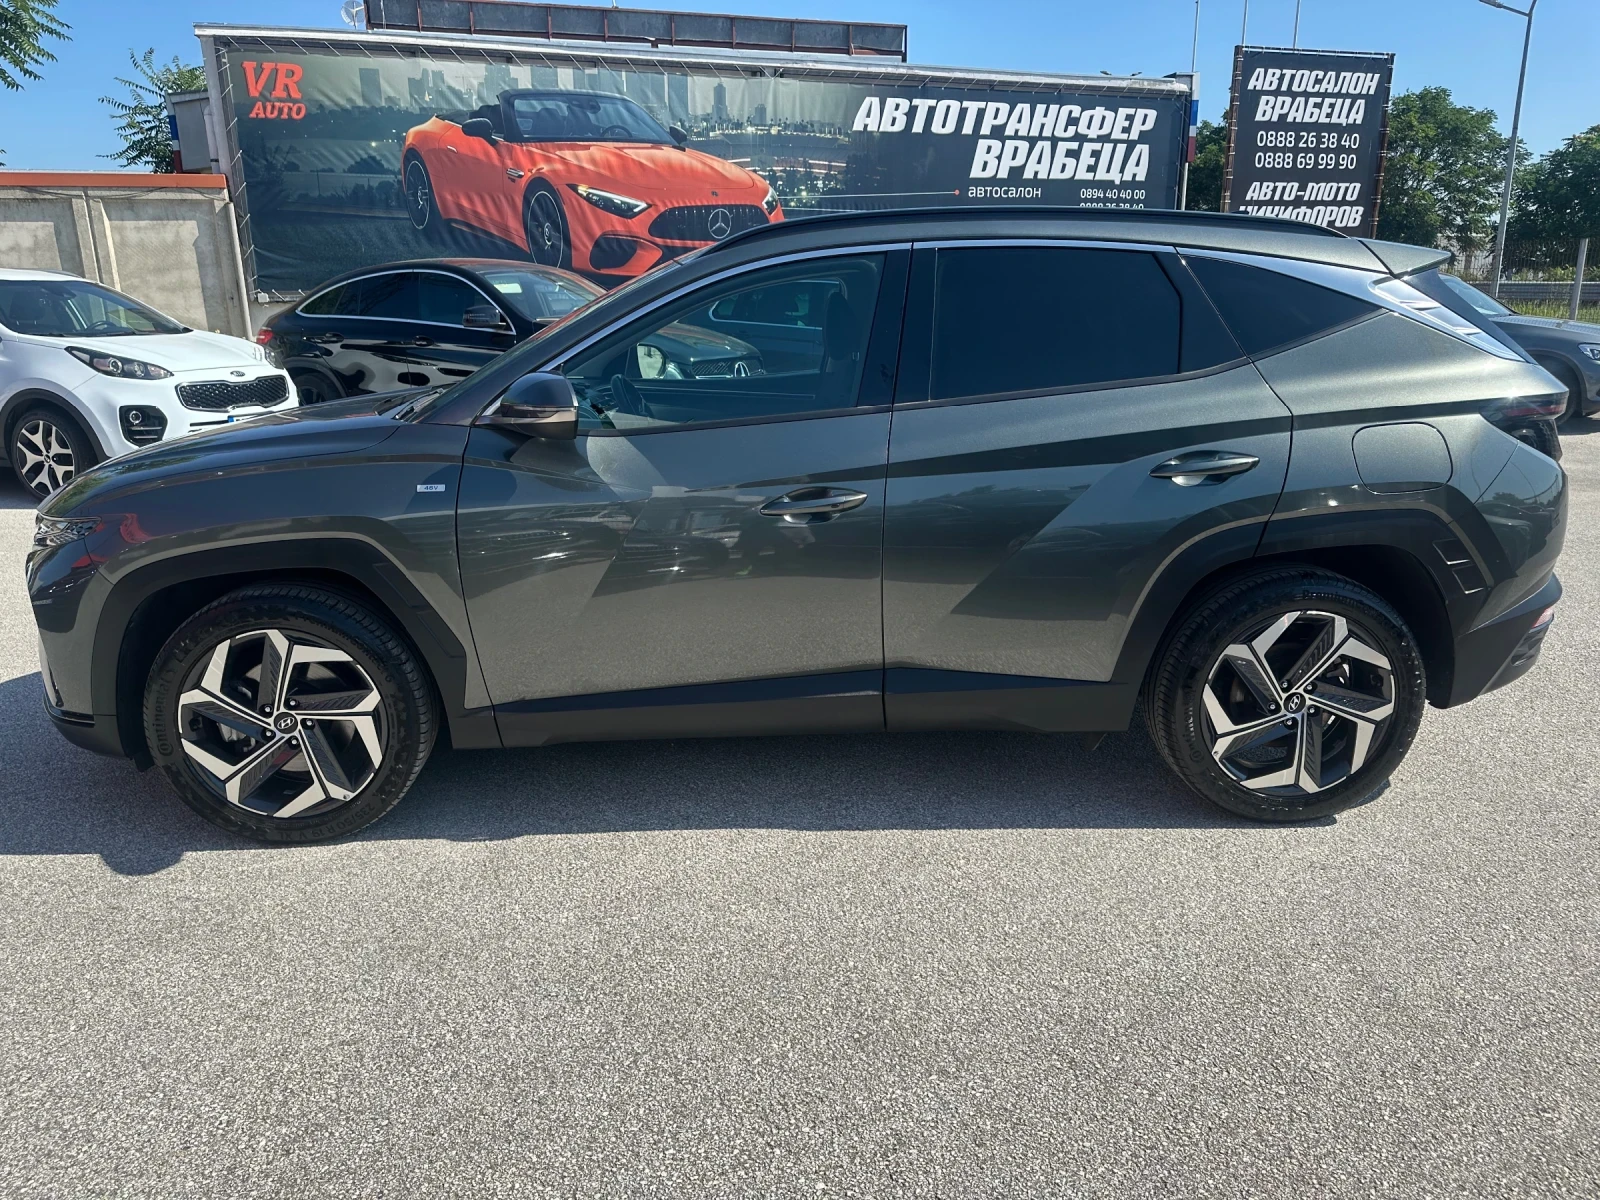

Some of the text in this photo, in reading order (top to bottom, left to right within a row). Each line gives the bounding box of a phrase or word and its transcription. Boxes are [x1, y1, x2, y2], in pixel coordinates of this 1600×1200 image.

[241, 61, 304, 100] VR
[1247, 67, 1380, 95] АВТОСАЛОН
[248, 101, 307, 120] AUTO
[853, 96, 1157, 141] АВТОТРАНСФЕР
[1254, 95, 1366, 127] ВРАБЕЦА
[1257, 131, 1360, 149] 0888 26 38 40
[969, 139, 1151, 185] ВРАБЕЦА
[1255, 152, 1357, 170] 0888 69 99 90
[968, 186, 1042, 198] автосалон
[1080, 188, 1146, 200] 0894 40 40 00
[1245, 181, 1362, 201] АВТО-МОТО
